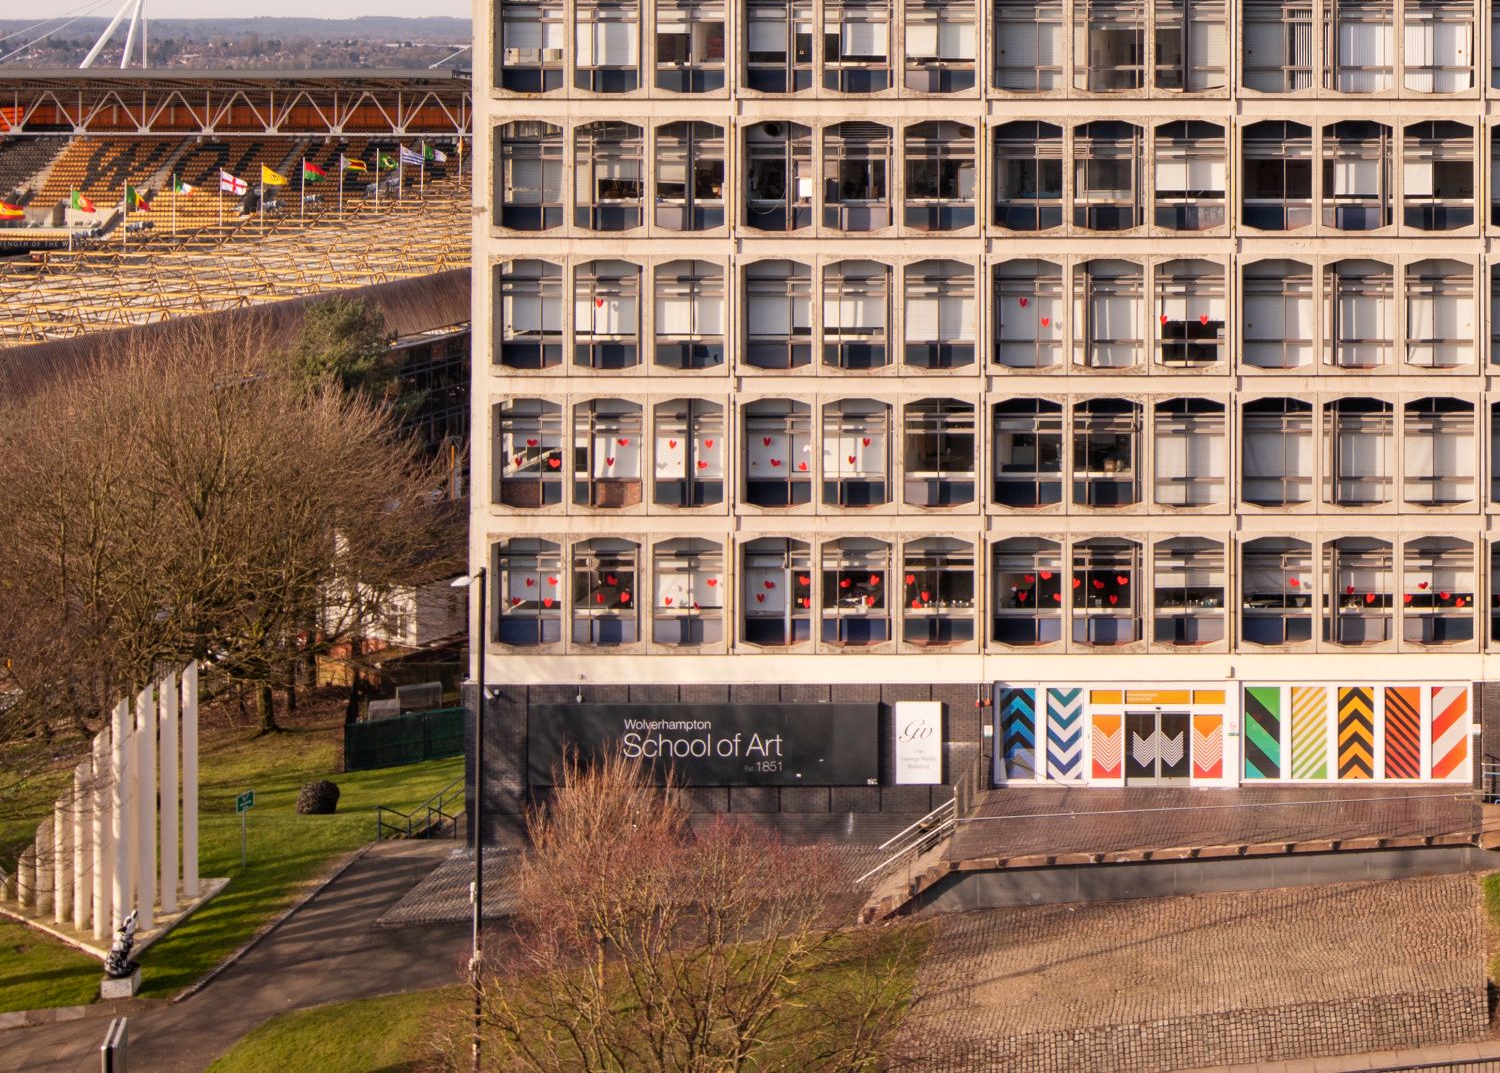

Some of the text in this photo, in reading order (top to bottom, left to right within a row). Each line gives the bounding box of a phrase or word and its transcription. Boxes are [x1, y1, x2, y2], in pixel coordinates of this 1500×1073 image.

[624, 719, 712, 731] Wolverhampton
[623, 733, 783, 757] School of Art
[756, 761, 783, 772] 1851
